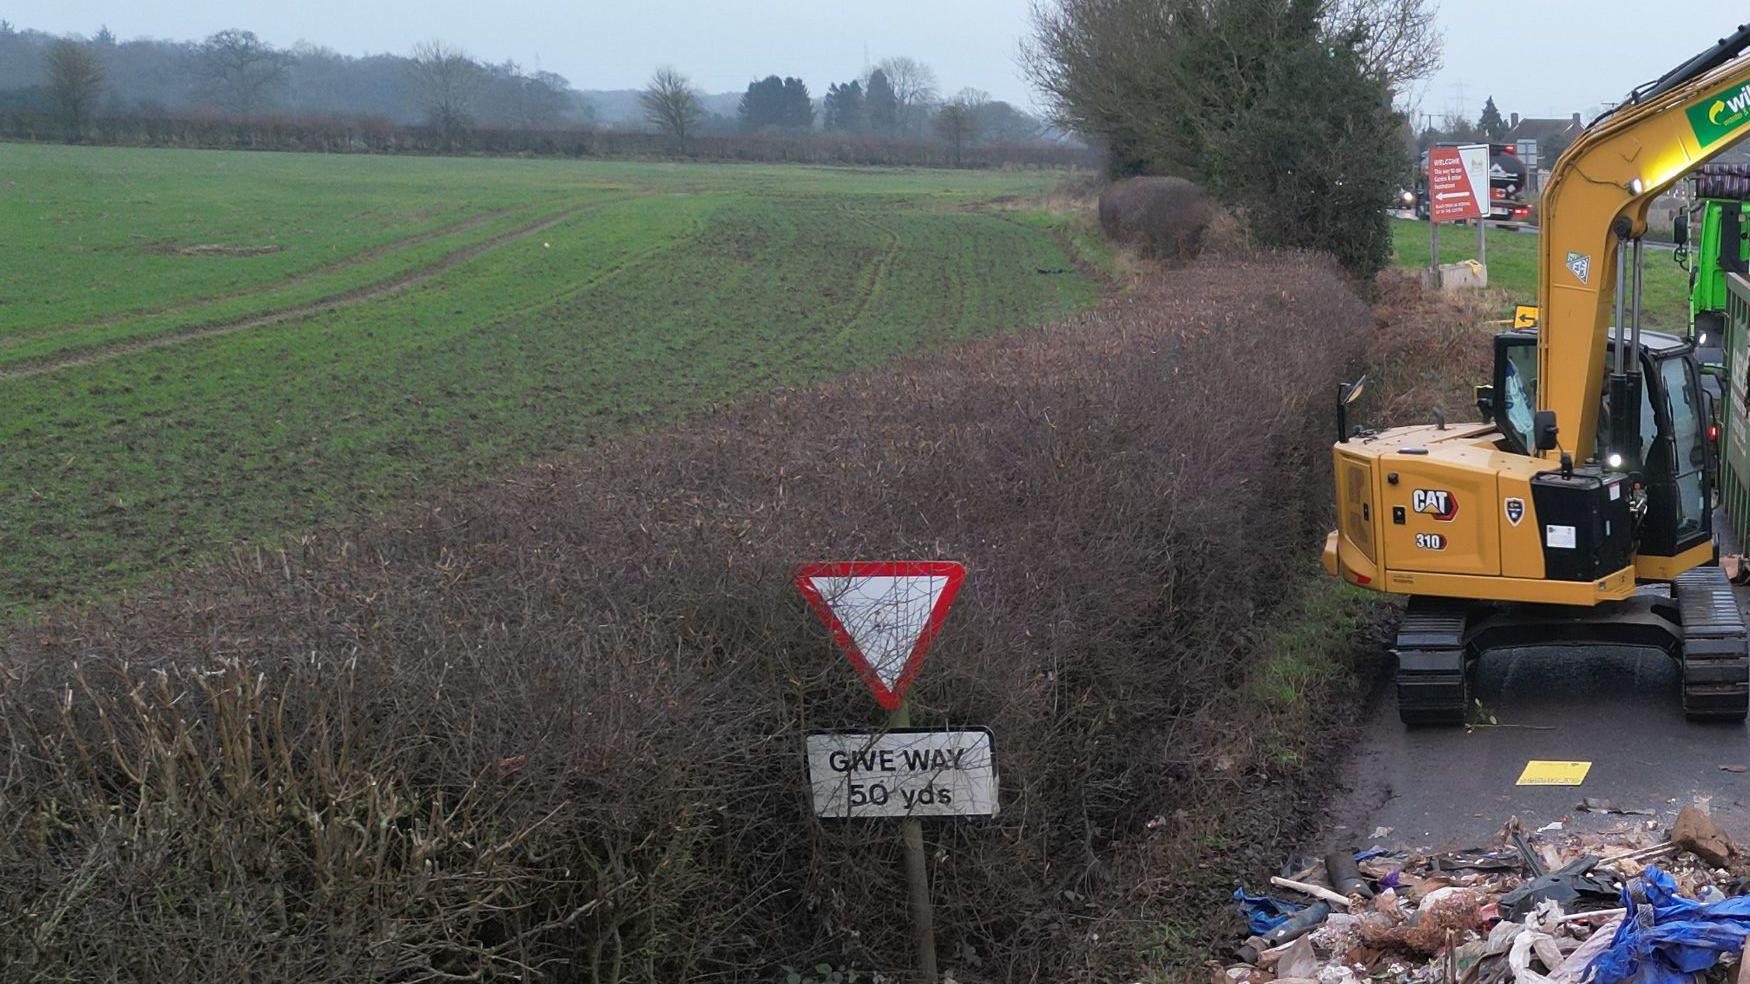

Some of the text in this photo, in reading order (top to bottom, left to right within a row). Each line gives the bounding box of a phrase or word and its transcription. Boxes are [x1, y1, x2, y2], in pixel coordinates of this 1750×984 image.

[1414, 490, 1448, 514] CAT
[1417, 534, 1440, 549] 310
[828, 748, 966, 773] GIVE WAY
[850, 783, 951, 810] 50 yds
